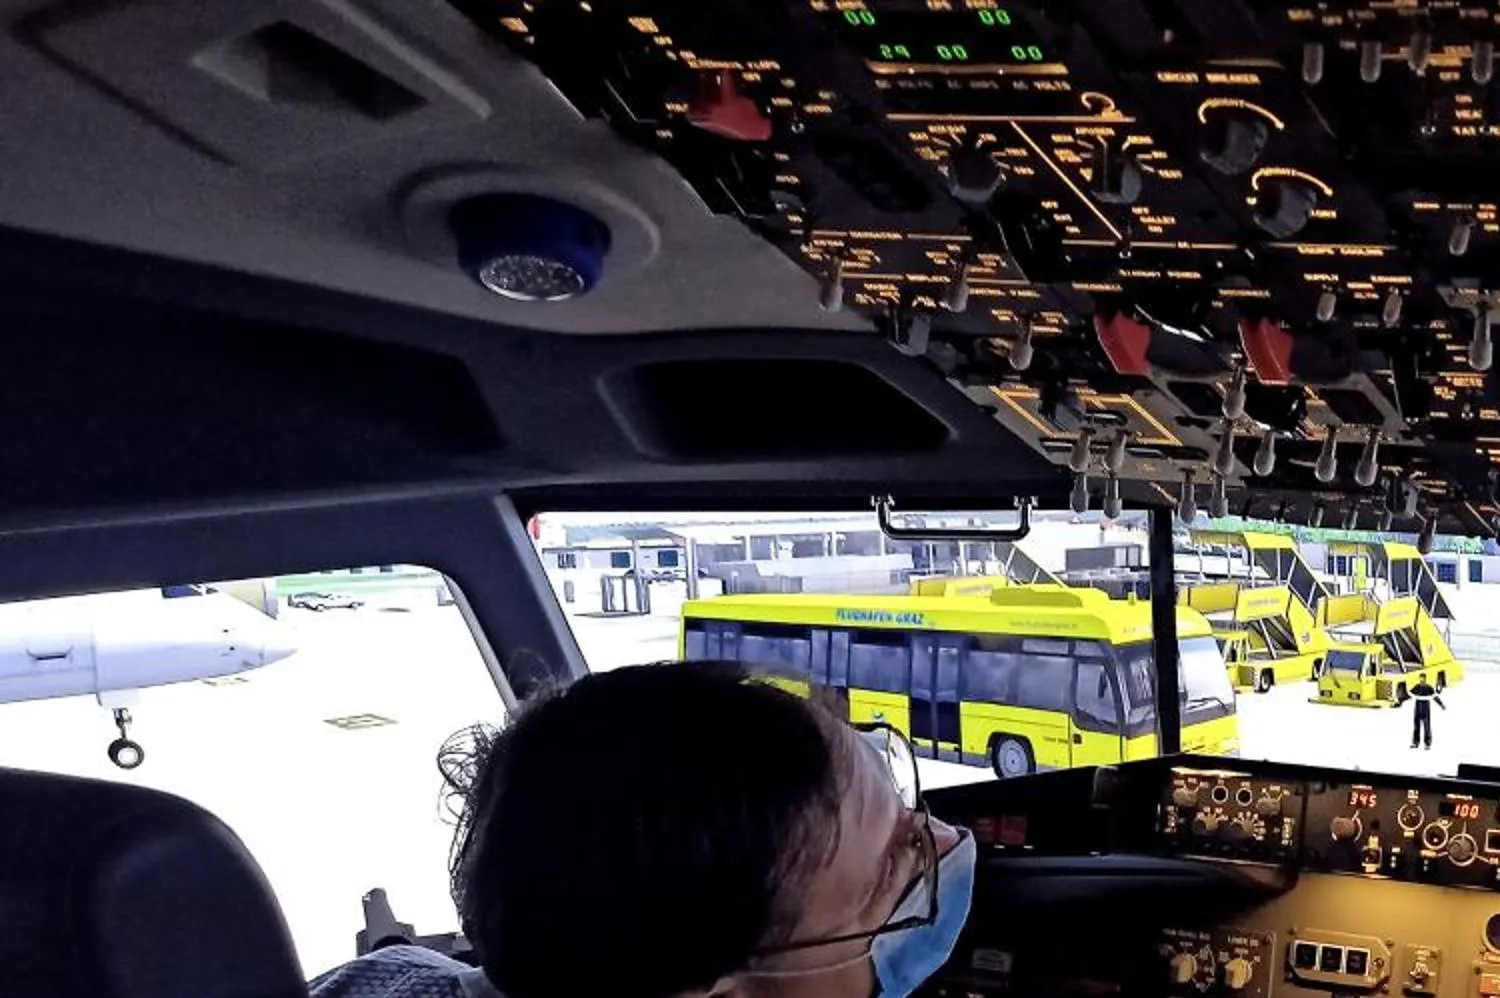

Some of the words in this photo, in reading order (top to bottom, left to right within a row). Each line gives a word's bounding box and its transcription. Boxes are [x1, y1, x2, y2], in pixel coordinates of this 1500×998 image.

[844, 9, 876, 26] 00
[978, 9, 1011, 26] 00
[879, 43, 911, 60] 29
[935, 44, 969, 60] 00
[1011, 45, 1043, 61] 00
[835, 607, 893, 624] FLUGHAFEN
[895, 611, 925, 626] GRAZ
[1349, 792, 1378, 809] 345
[1453, 803, 1480, 820] 100
